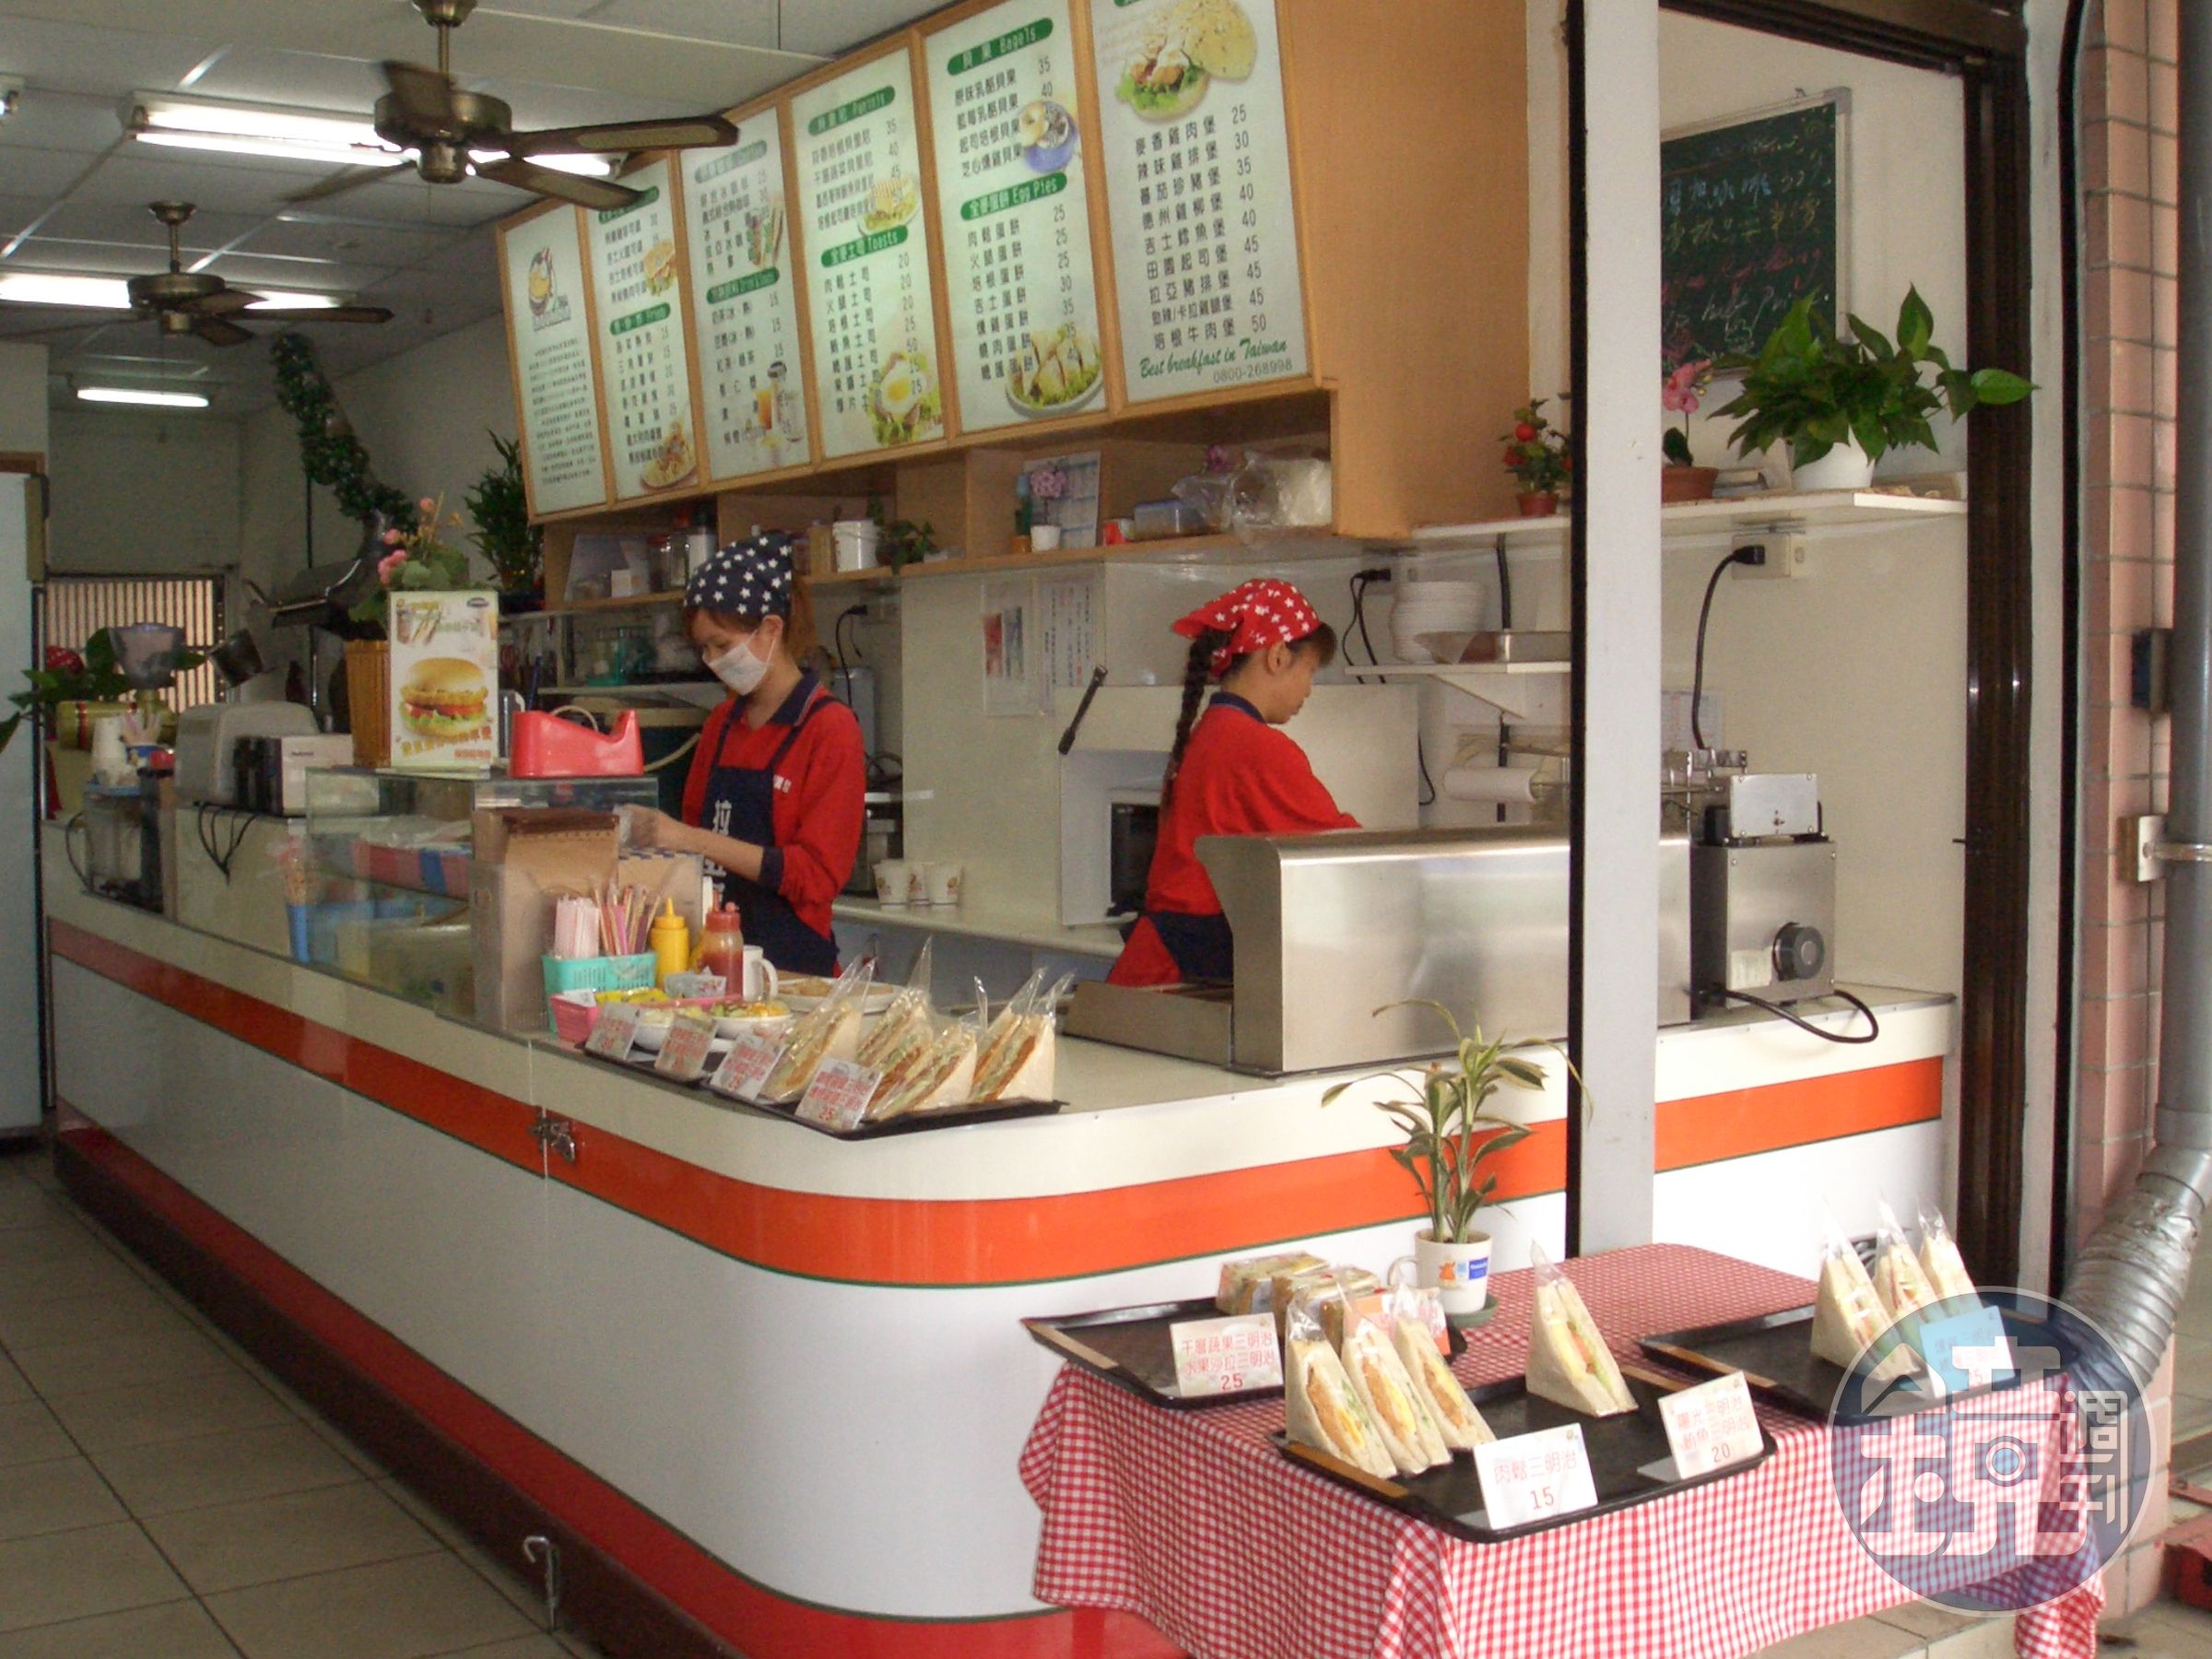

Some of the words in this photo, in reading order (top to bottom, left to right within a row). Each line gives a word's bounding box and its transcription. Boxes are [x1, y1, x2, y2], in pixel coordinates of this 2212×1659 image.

[1038, 54, 1051, 75] 35
[1040, 80, 1053, 99] 40
[1230, 102, 1247, 125] 25
[1234, 129, 1250, 150] 30
[1235, 154, 1252, 177] 35
[1033, 173, 1057, 197] Pies
[1238, 182, 1254, 203] 40
[1053, 202, 1065, 223] 25
[1241, 207, 1256, 229] 40
[1054, 226, 1068, 246] 25
[1243, 233, 1259, 254] 45
[1057, 250, 1069, 269] 25
[1245, 259, 1262, 281] 45
[1059, 273, 1072, 292] 30
[1062, 297, 1075, 315] 35
[1248, 286, 1264, 307] 45
[1251, 312, 1266, 333] 50
[1139, 353, 1164, 379] Best
[1167, 341, 1222, 382] breakfast
[1224, 344, 1235, 362] in
[1239, 329, 1288, 360] Taiwan
[1220, 1374, 1243, 1391] 25
[1712, 1443, 1731, 1463] 20
[1531, 1486, 1555, 1511] 15
